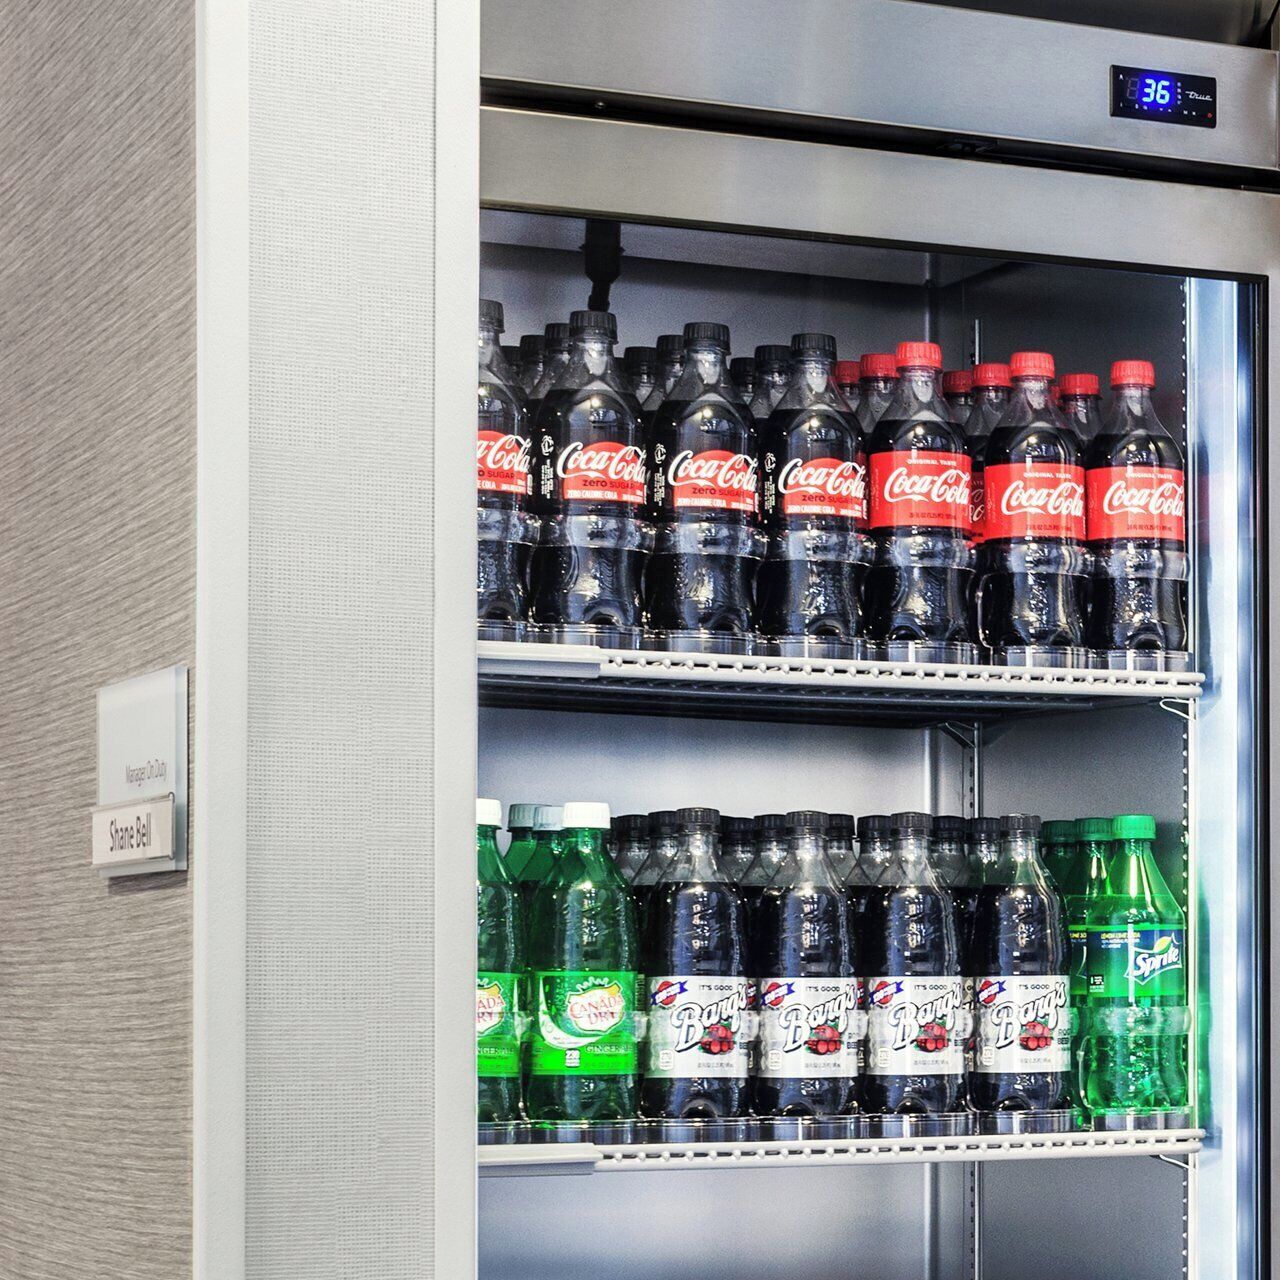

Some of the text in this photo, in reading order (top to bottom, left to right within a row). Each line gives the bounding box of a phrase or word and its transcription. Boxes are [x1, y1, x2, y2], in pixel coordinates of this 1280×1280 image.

[1142, 79, 1170, 104] 36
[109, 813, 152, 852] Shane Bell
[1134, 947, 1179, 977] Sprite
[588, 1010, 616, 1025] DRY
